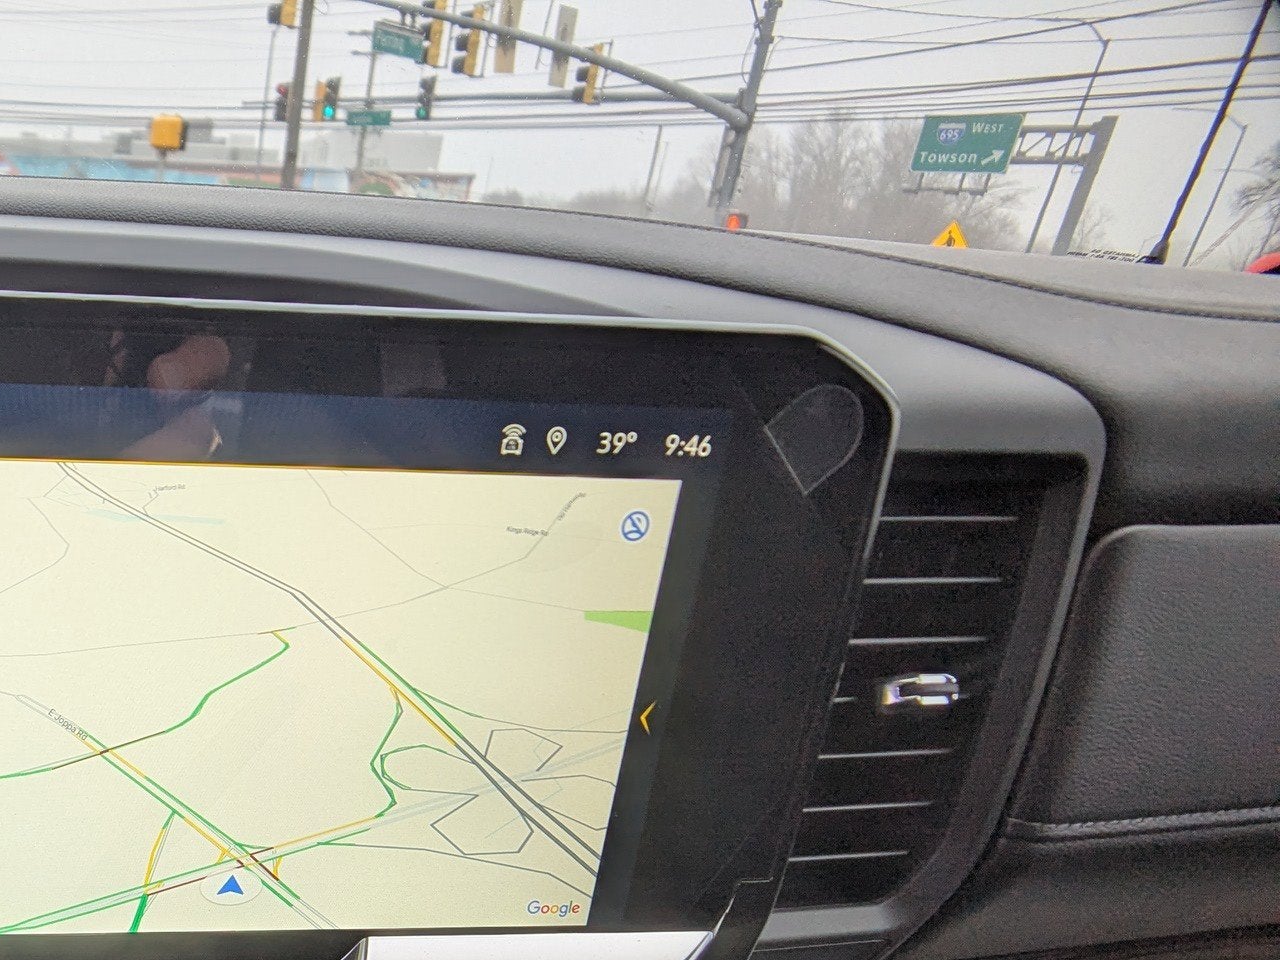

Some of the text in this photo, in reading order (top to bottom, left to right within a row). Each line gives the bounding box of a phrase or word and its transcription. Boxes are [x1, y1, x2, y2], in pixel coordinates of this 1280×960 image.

[939, 128, 961, 141] 695
[920, 151, 978, 164] Towson
[665, 434, 713, 457] 9:46
[48, 708, 88, 741] E Joppa Rd
[527, 900, 580, 918] Google
